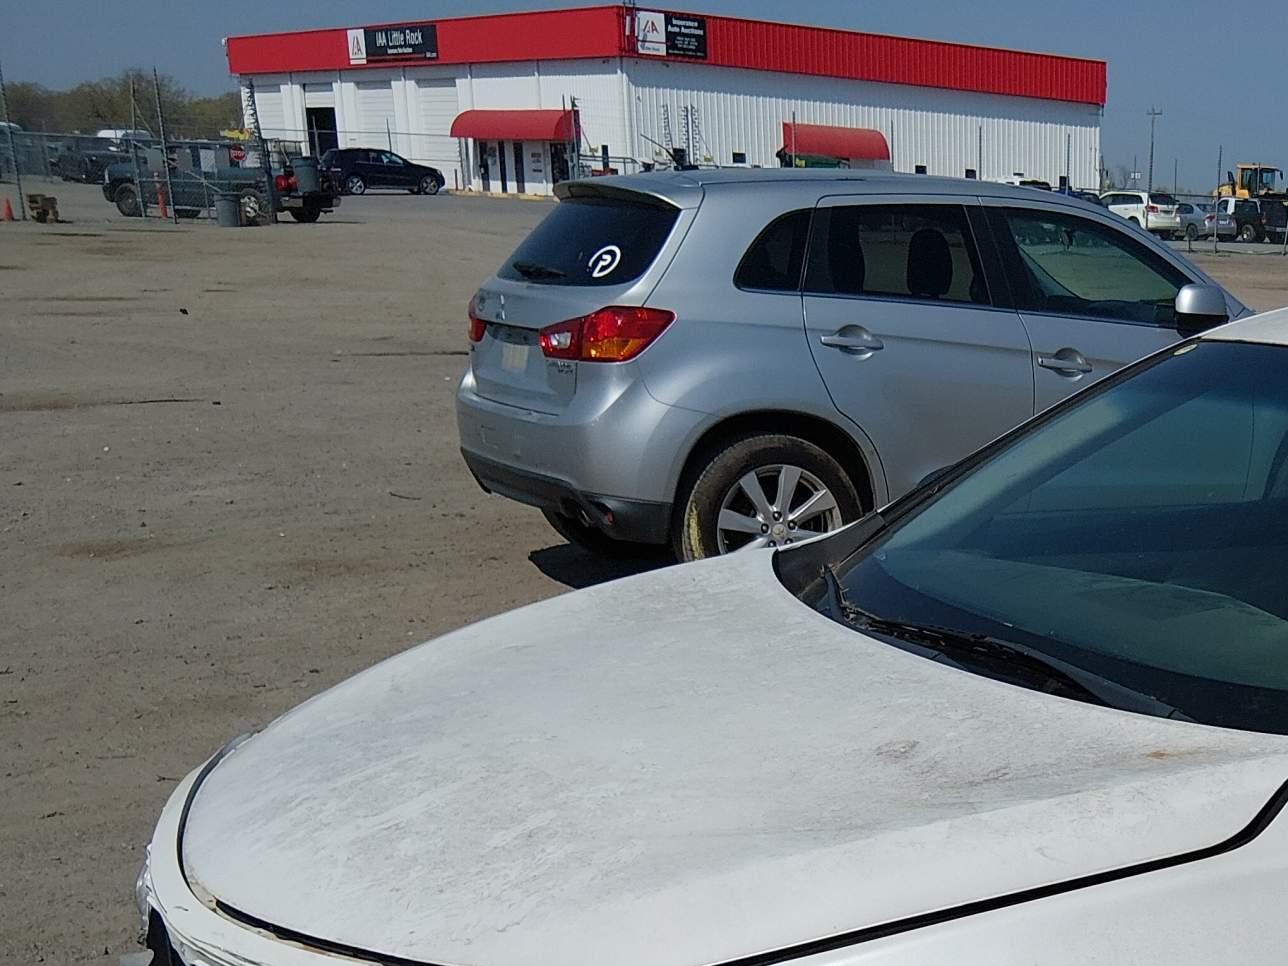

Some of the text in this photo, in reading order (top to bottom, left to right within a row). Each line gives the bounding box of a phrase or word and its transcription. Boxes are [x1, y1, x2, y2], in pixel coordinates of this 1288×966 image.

[375, 29, 423, 47] IAA Little Rock
